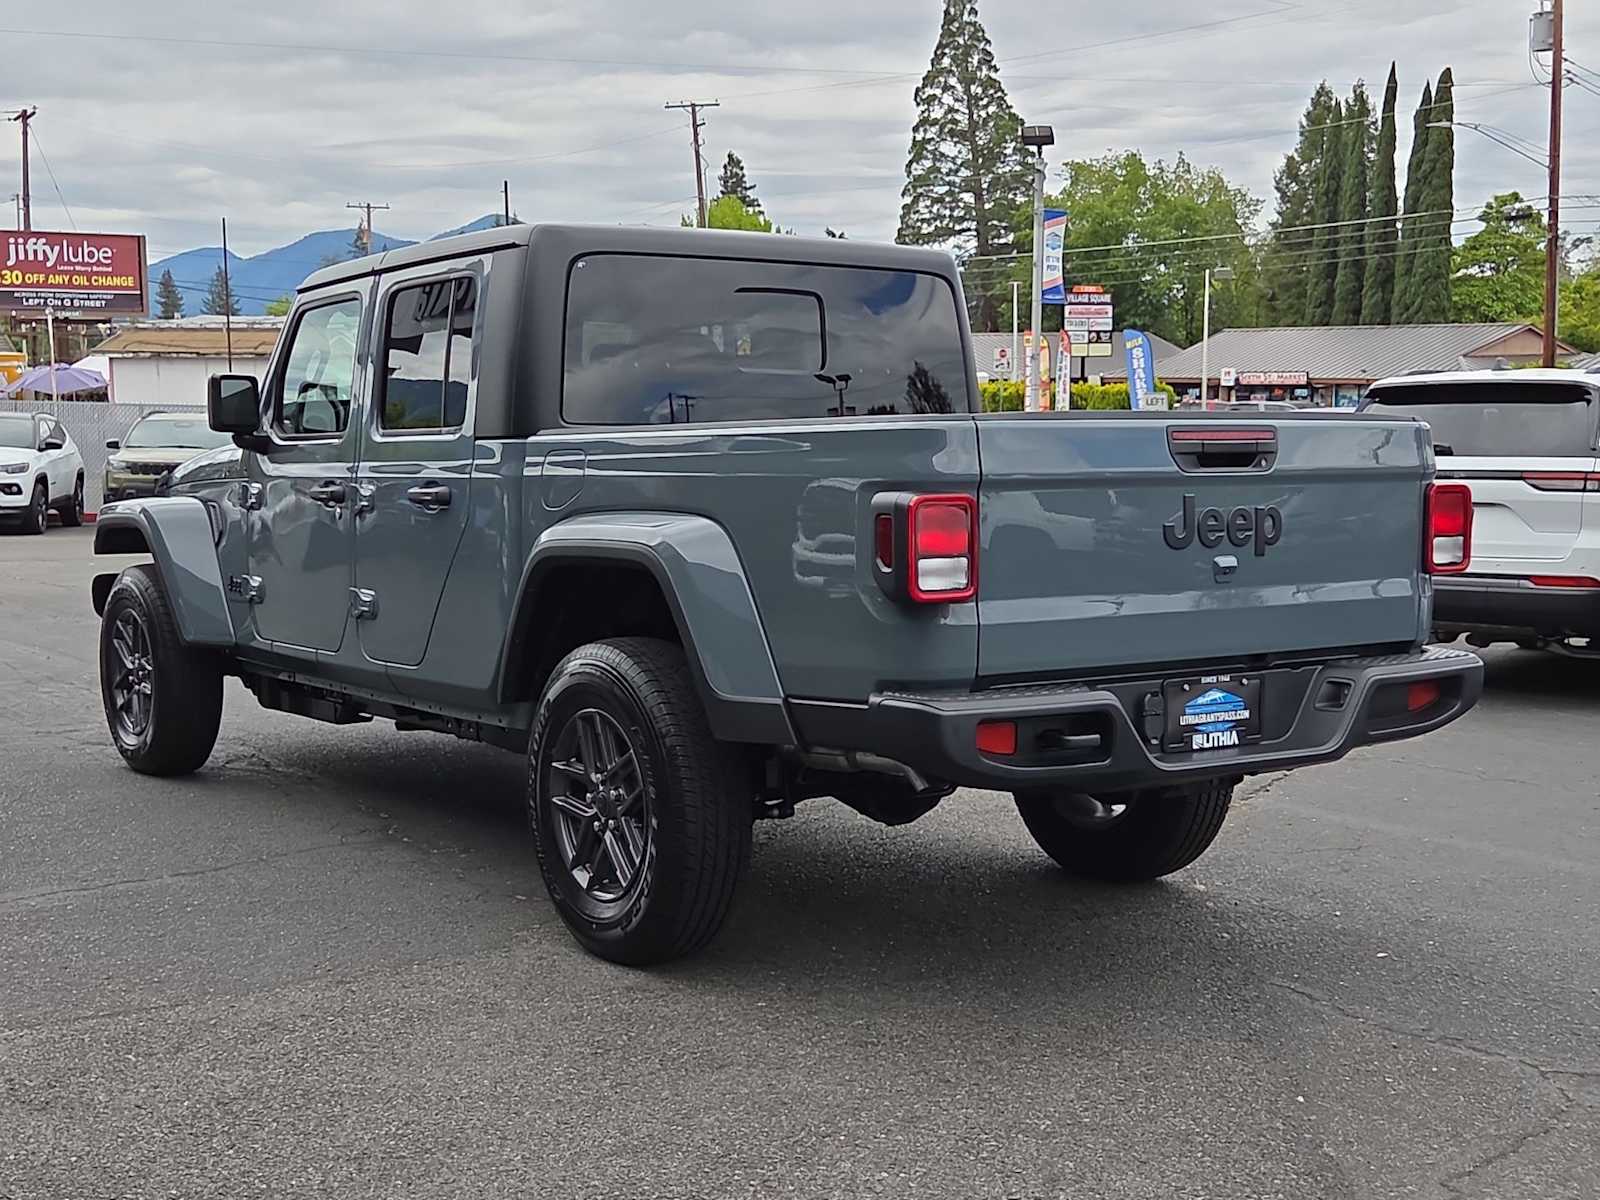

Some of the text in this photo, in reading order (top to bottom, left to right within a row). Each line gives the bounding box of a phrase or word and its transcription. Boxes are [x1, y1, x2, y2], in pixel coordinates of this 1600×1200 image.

[0, 269, 135, 287] 30 OFF ANY OIL CHANGE
[22, 297, 45, 306] LEFT
[46, 298, 61, 306] ON
[72, 299, 106, 307] STREET
[1146, 397, 1165, 406] LEFT
[1163, 493, 1282, 557] Jeep
[1204, 731, 1239, 748] LITHIA
